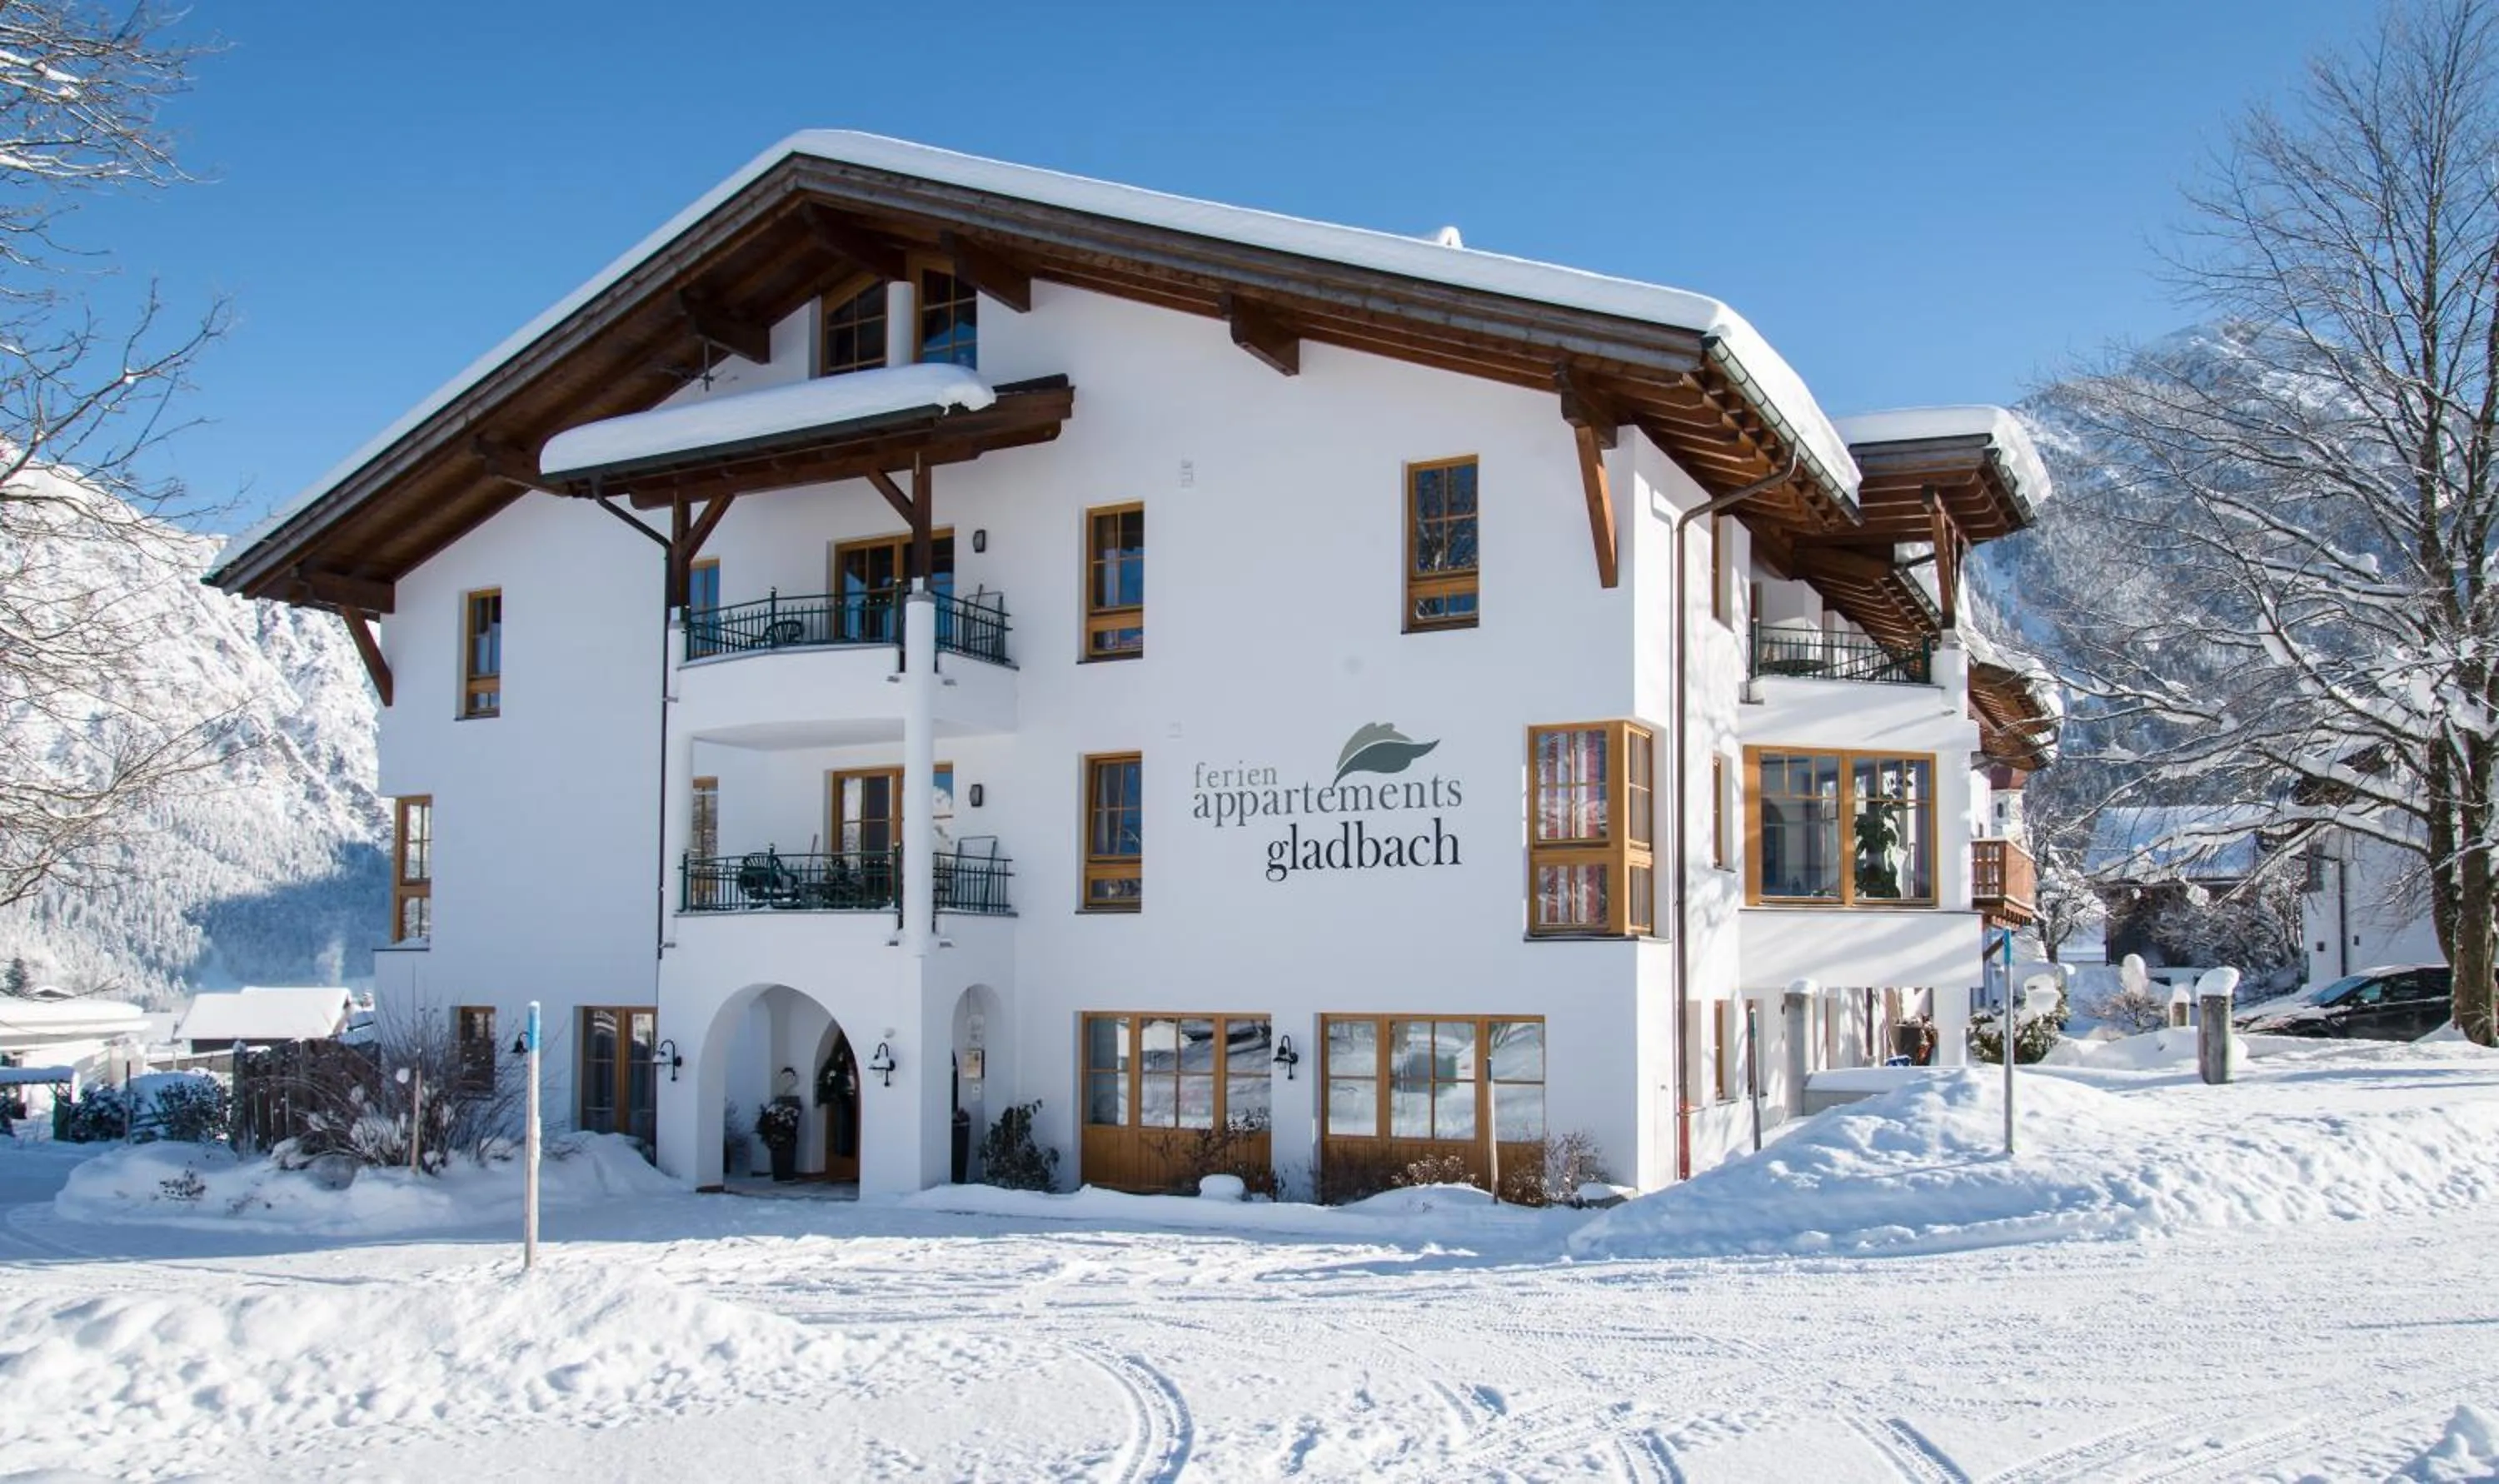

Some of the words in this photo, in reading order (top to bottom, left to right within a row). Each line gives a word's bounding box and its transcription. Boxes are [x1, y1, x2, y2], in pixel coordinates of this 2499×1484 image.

[1193, 760, 1278, 789] ferien
[1193, 774, 1463, 828] appartements
[1265, 817, 1463, 882] gladbach
